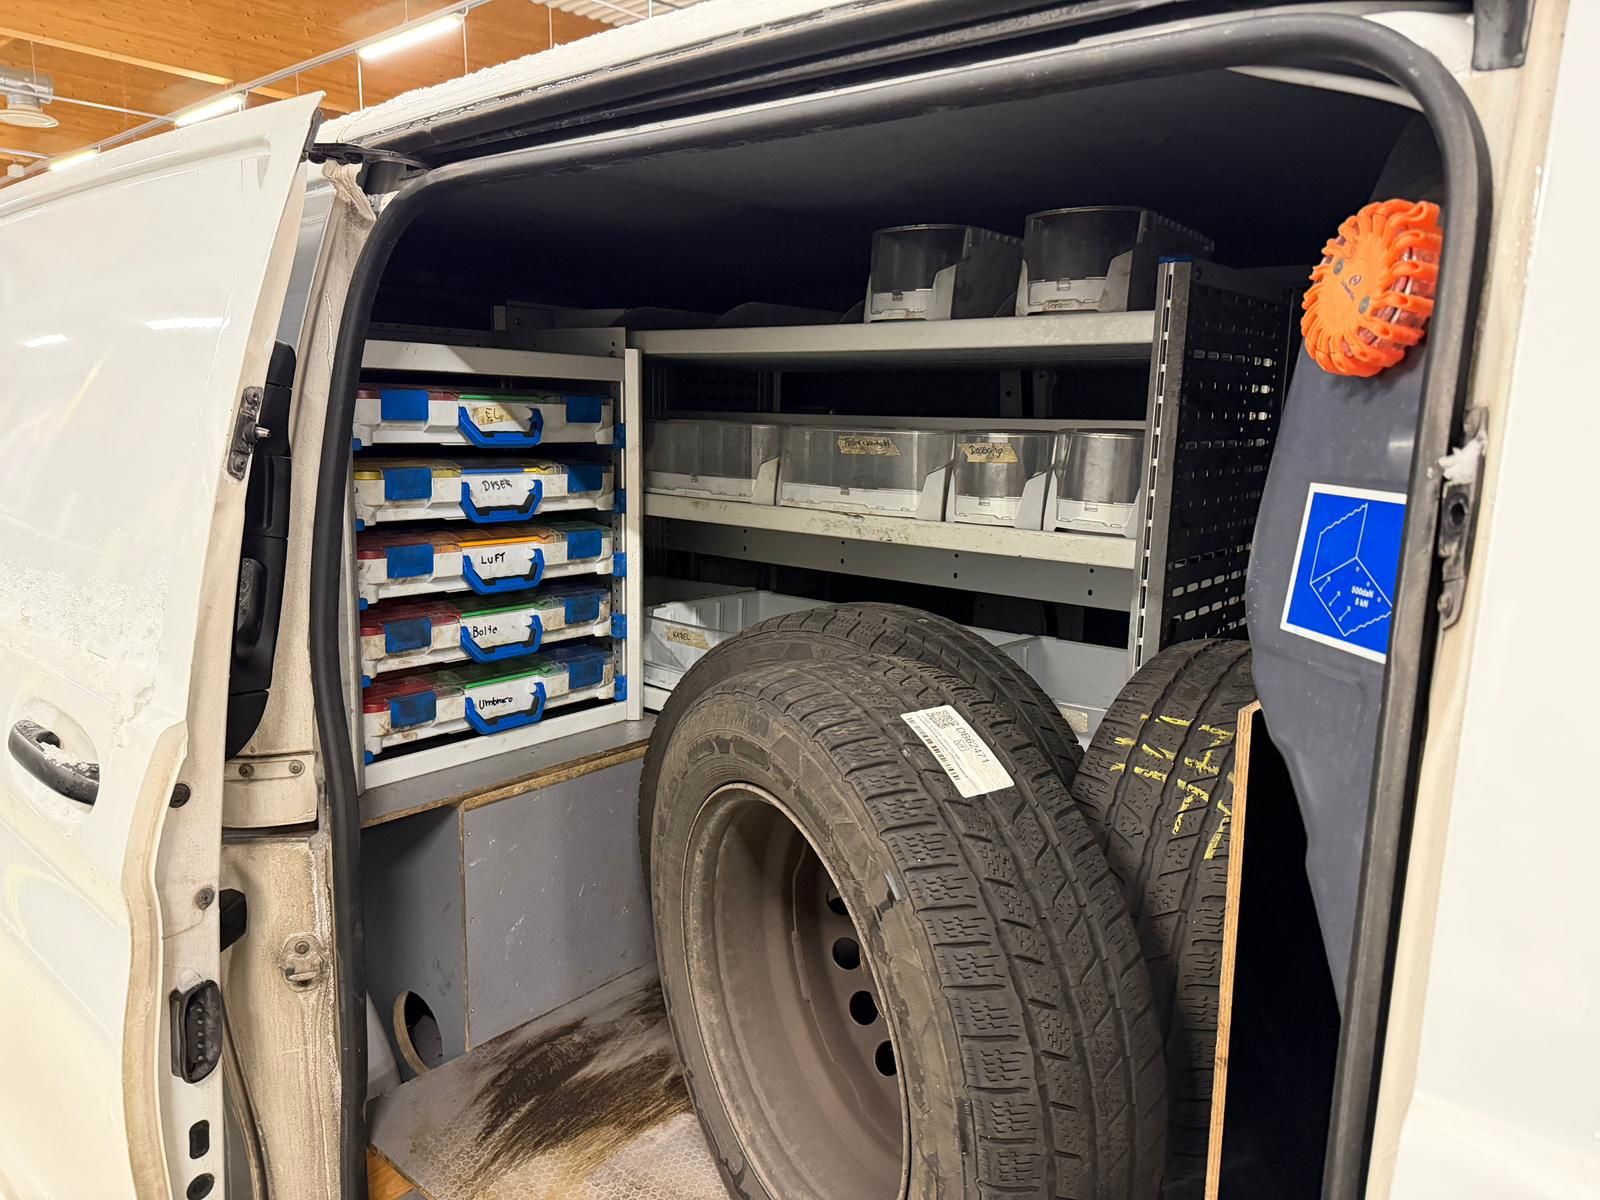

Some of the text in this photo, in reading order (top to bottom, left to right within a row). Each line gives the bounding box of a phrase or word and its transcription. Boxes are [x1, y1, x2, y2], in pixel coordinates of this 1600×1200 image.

[485, 407, 504, 422] EL
[480, 551, 506, 565] LUFT
[1354, 597, 1359, 606] 5
